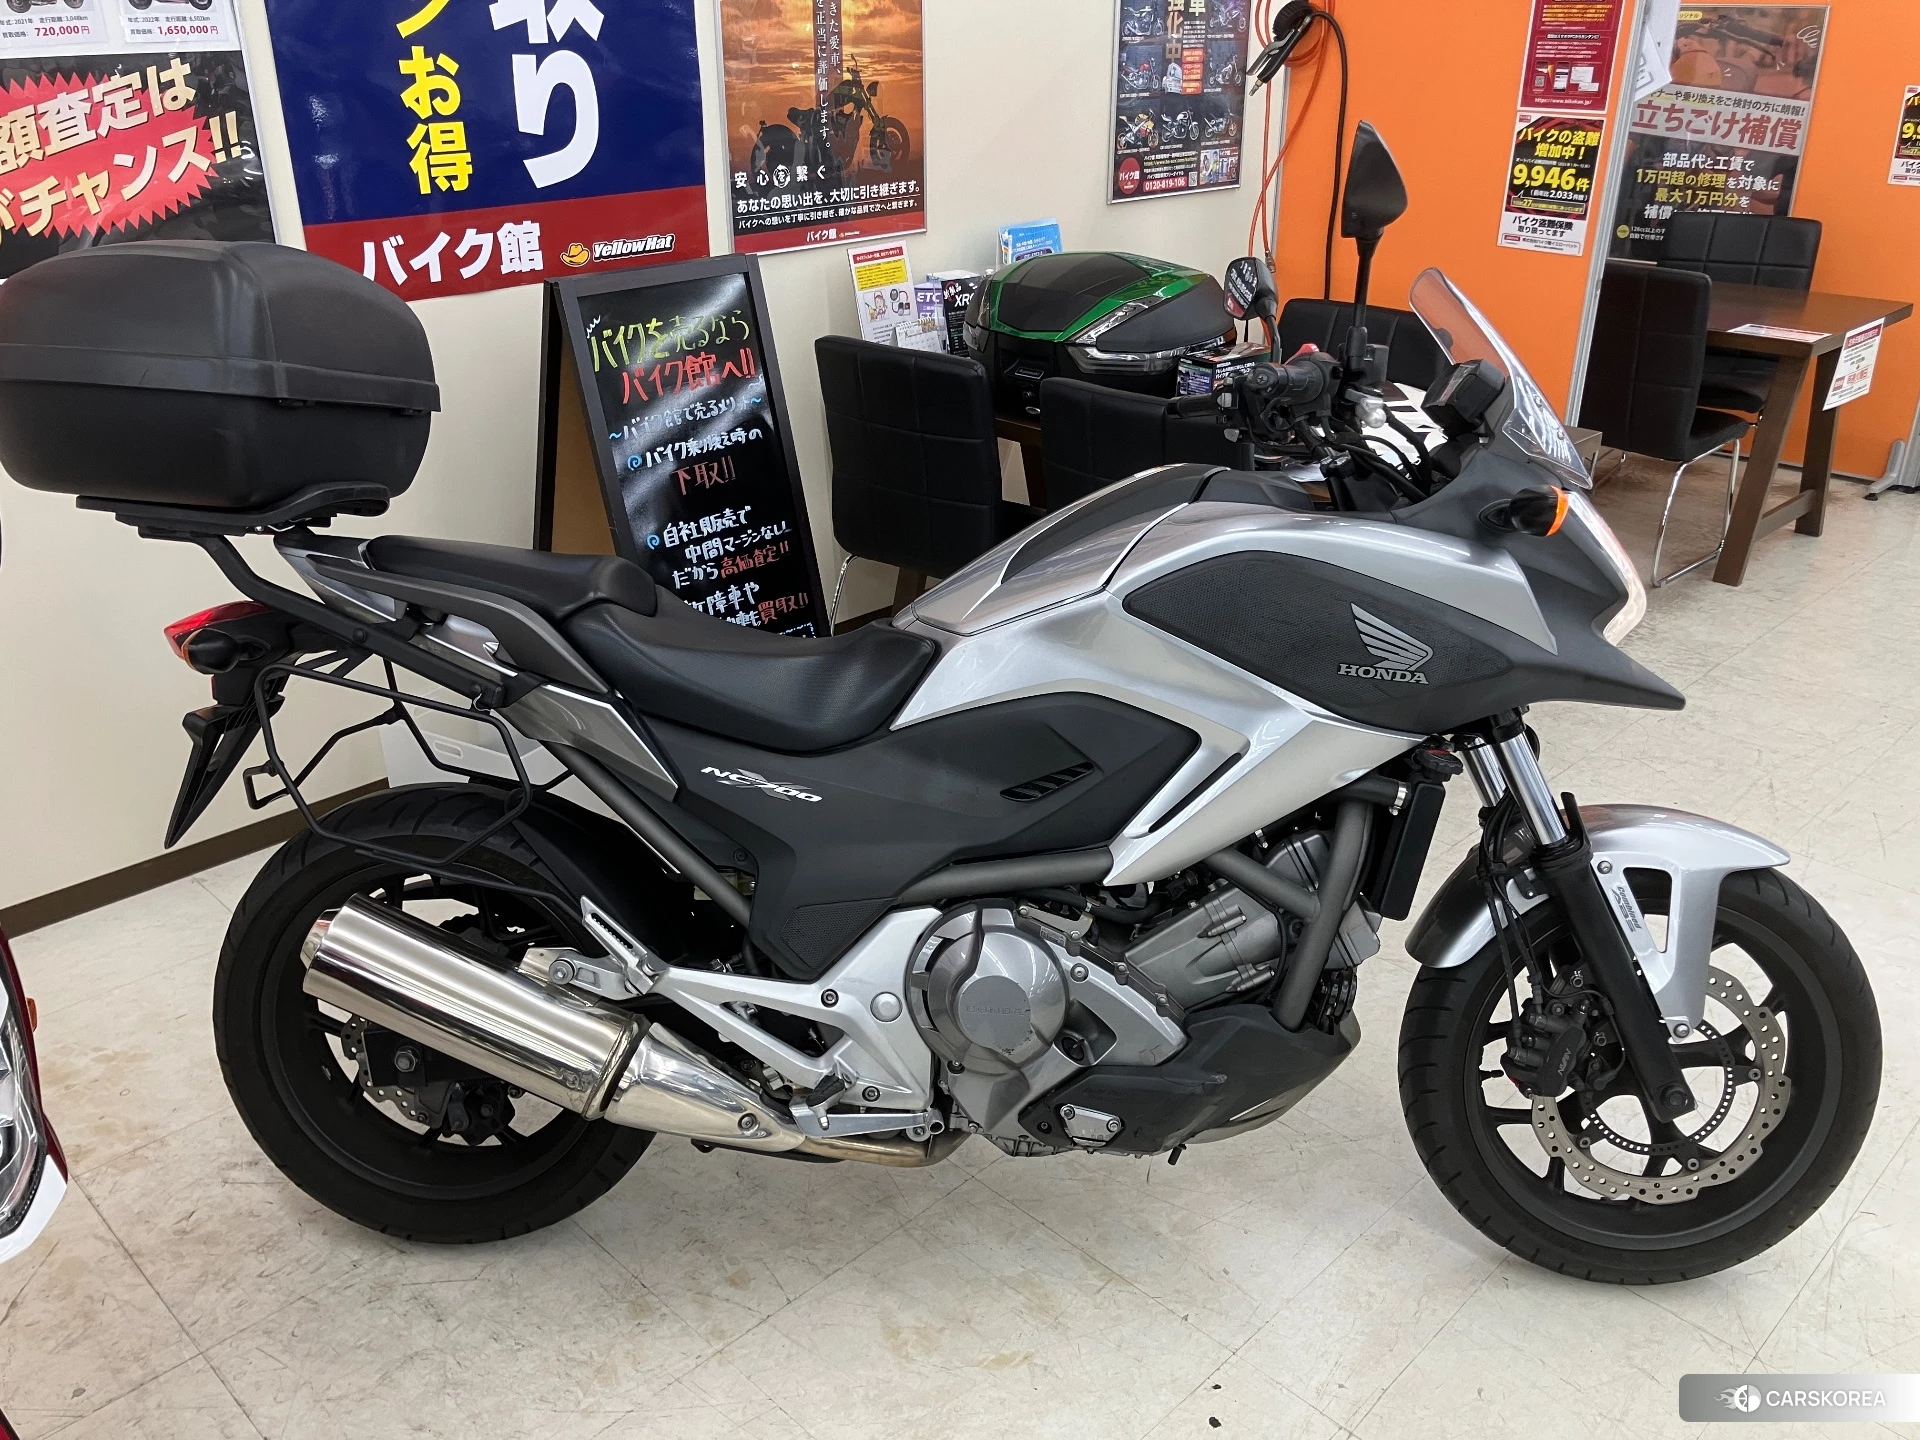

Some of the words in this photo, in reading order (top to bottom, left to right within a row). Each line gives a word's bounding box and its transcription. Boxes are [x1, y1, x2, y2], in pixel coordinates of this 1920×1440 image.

[34, 25, 90, 37] 720,000円
[158, 25, 218, 35] 1,650,000円
[1632, 99, 1803, 149] 立ちごけ補償
[1518, 128, 1601, 146] バイクの盗難
[1534, 143, 1586, 160] 増加中!
[1662, 151, 1755, 171] 部品代と工賃で
[1145, 178, 1186, 190] 0120-819-106
[1513, 163, 1590, 192] 9,946件
[1636, 168, 1779, 191] 1万円超の修理を対象に
[1654, 188, 1750, 208] 最大1万円分を
[1513, 216, 1573, 231] バイク盗難保険
[362, 220, 545, 286] バイク館
[591, 309, 750, 372] バイクを売るなら
[663, 505, 752, 547] 自社販売で
[1338, 663, 1429, 684] HONDA
